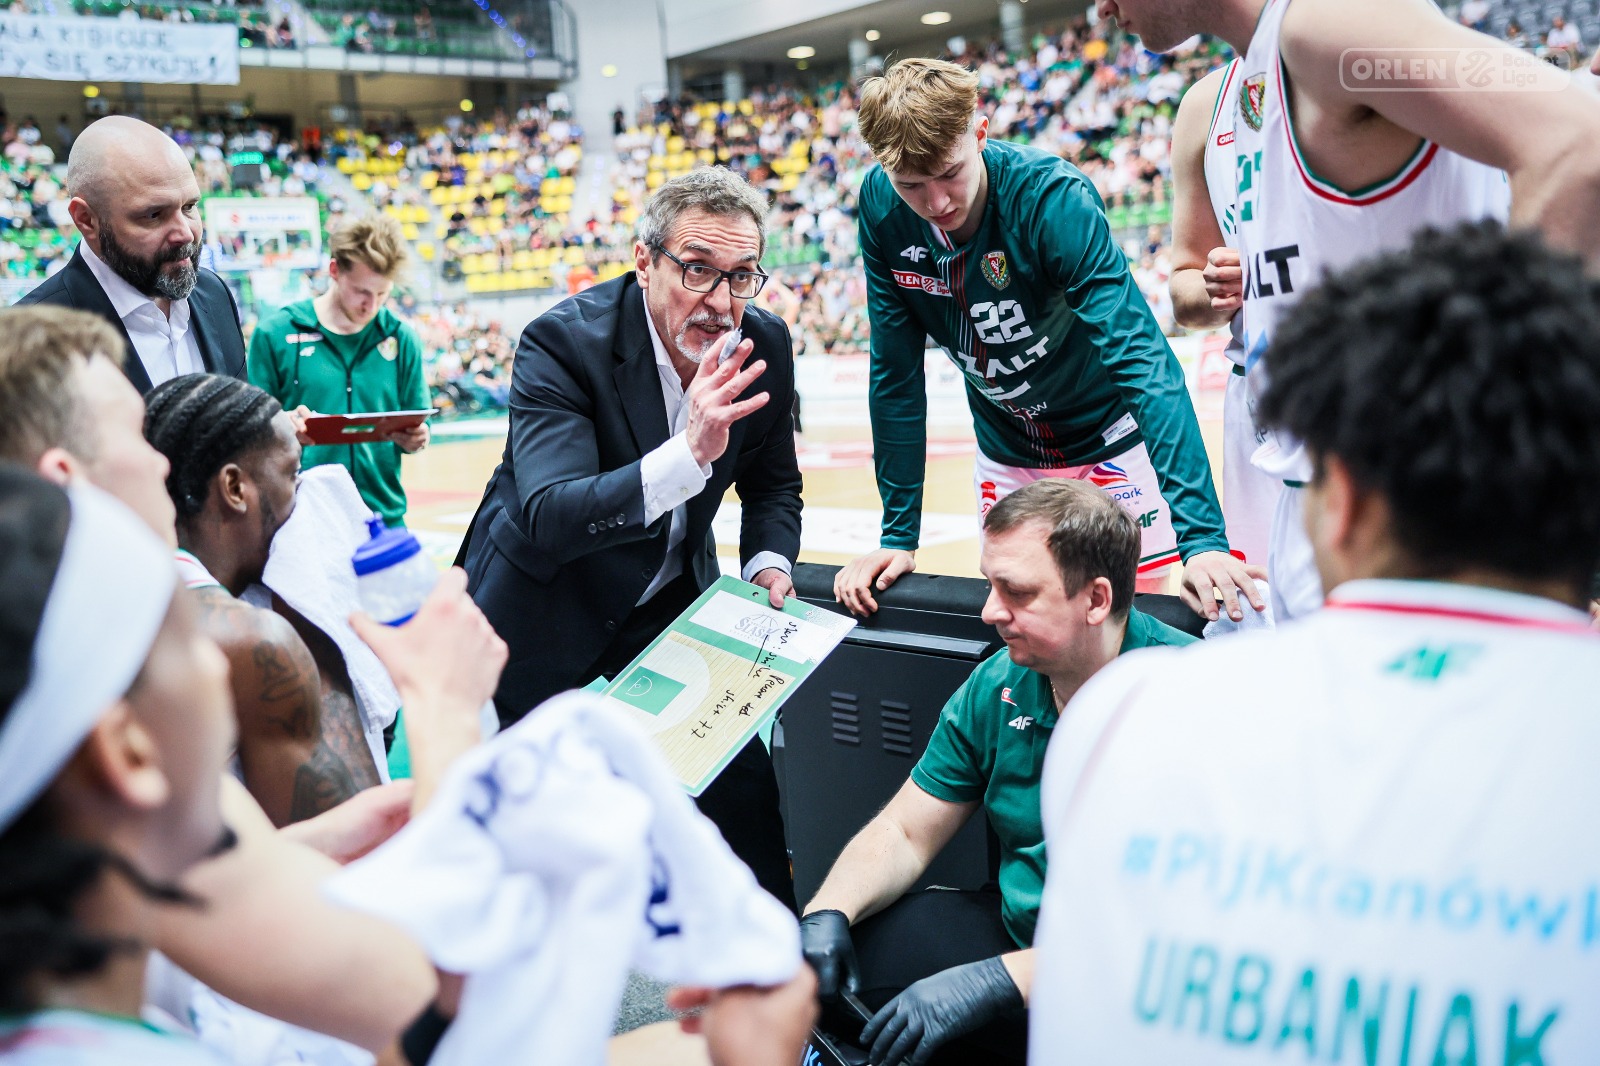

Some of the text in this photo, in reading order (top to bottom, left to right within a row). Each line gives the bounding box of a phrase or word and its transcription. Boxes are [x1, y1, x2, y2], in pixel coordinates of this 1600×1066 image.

[1219, 132, 1234, 144] ORL
[900, 245, 930, 263] 4F
[892, 273, 921, 286] RLEN
[970, 300, 1033, 344] 22
[942, 336, 1049, 378] ZALT
[1113, 487, 1143, 501] park
[1008, 715, 1035, 730] 4F
[1132, 934, 1560, 1066] URBANIAK
